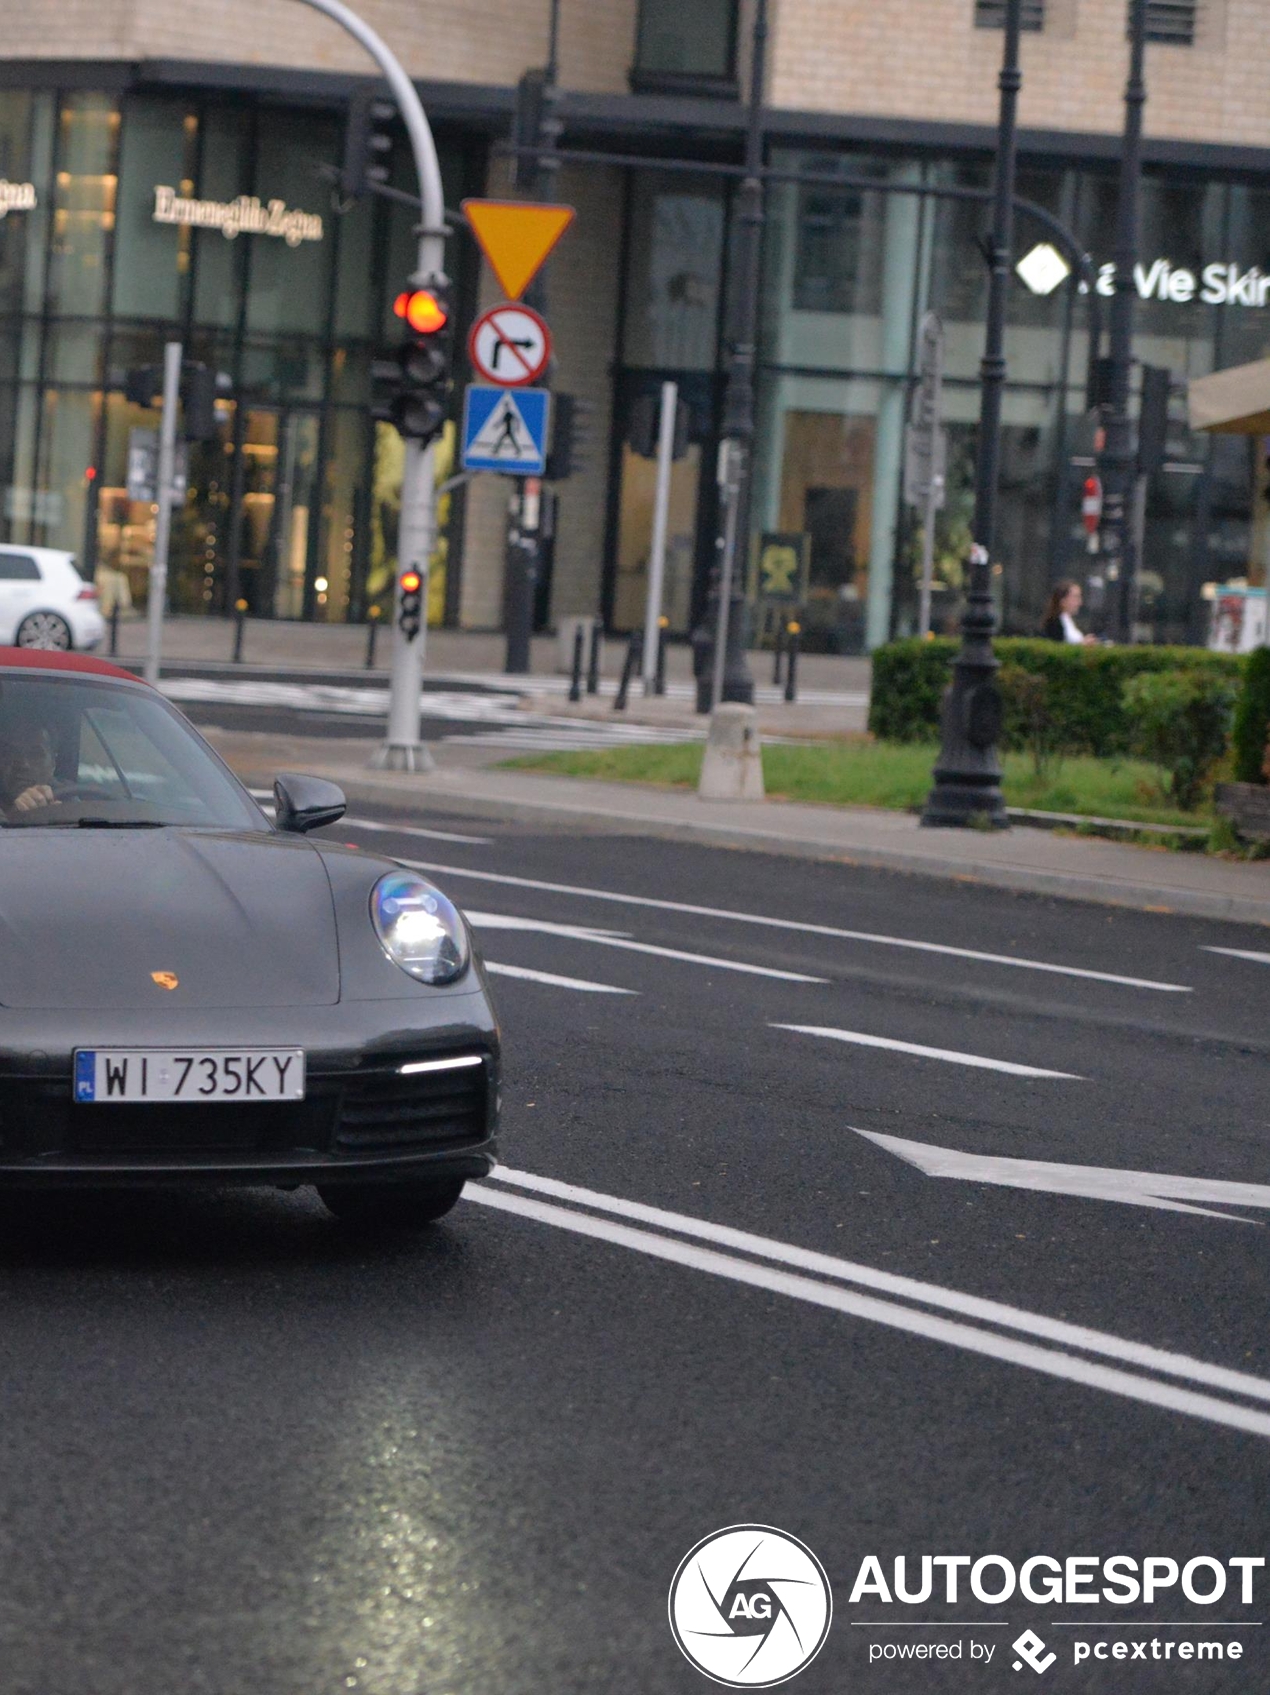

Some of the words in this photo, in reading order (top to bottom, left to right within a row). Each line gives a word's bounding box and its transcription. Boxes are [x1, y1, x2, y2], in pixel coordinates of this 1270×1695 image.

[152, 184, 270, 240] Ermenegildo
[266, 199, 323, 247] Zegna
[1133, 258, 1196, 302] Vie
[105, 1057, 147, 1096] WI
[173, 1056, 292, 1095] 735KY
